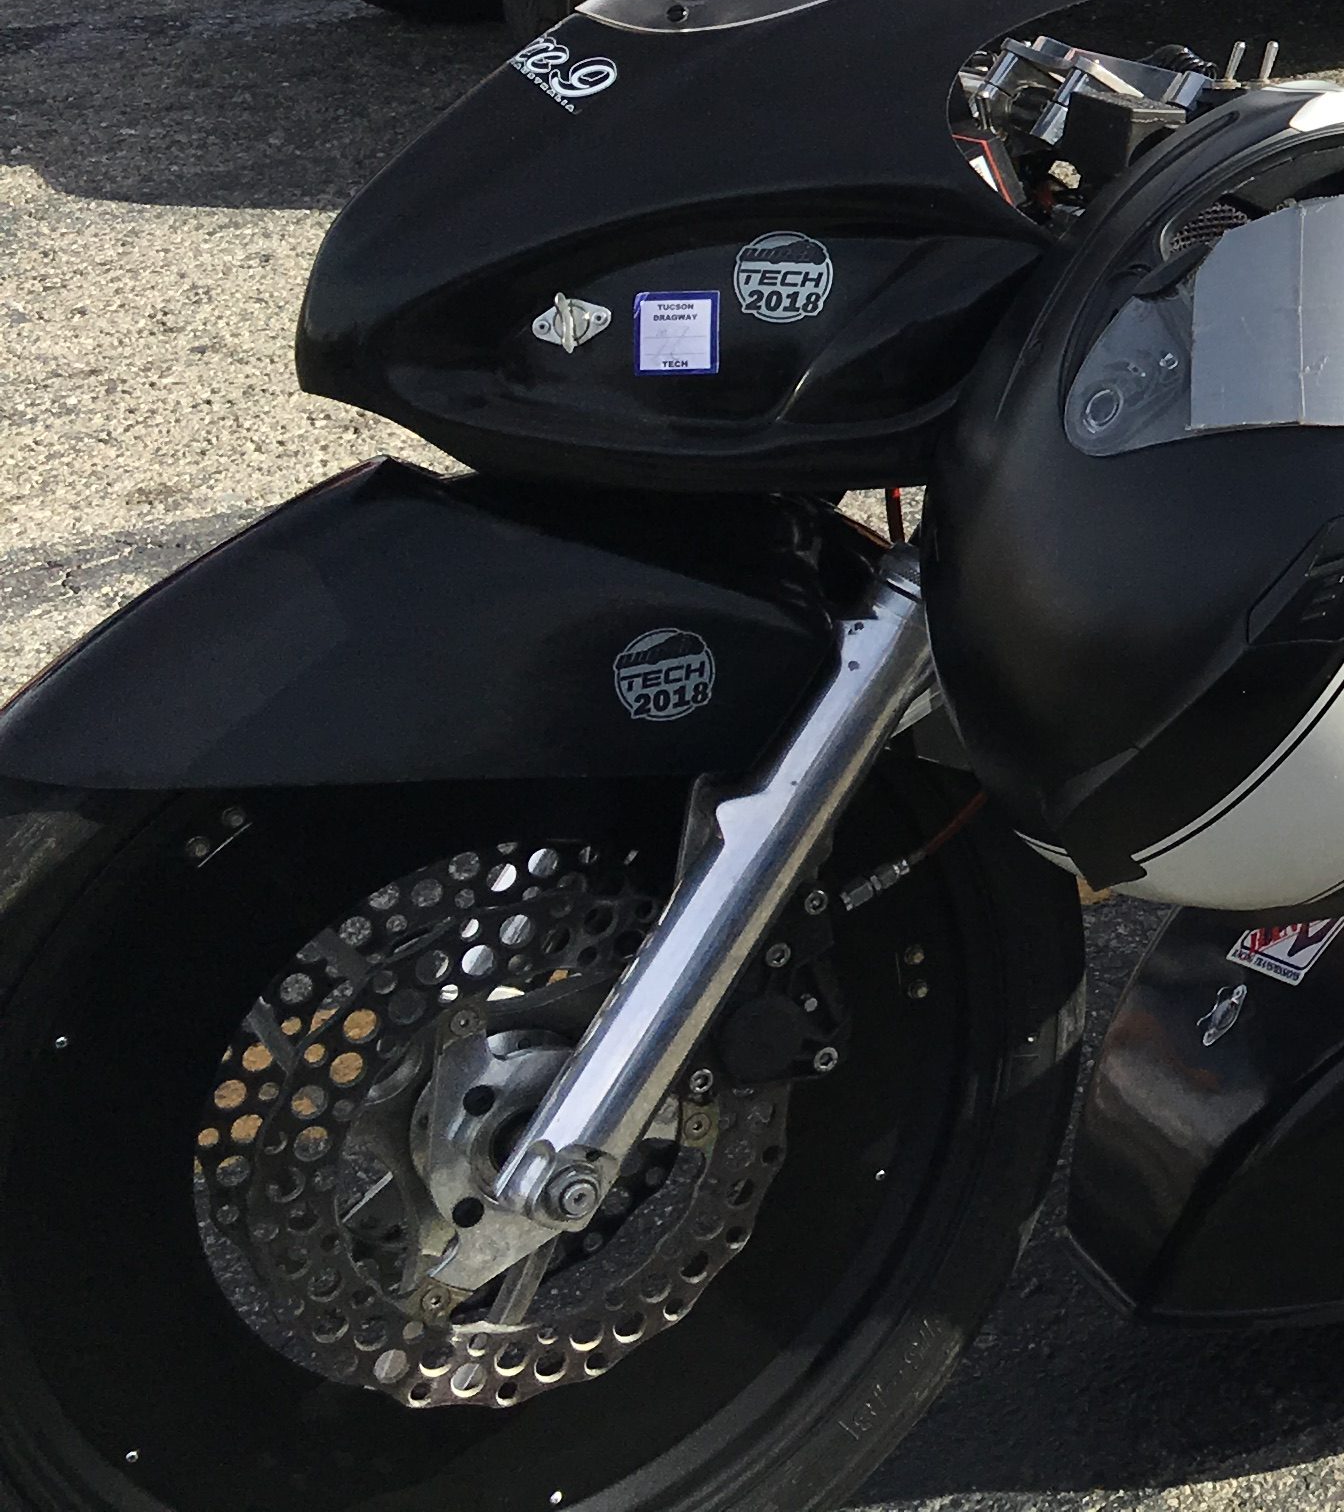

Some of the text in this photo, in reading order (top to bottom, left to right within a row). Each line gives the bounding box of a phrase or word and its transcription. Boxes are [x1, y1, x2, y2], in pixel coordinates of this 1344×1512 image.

[740, 268, 824, 289] TECH
[656, 302, 695, 312] TUCSON
[744, 289, 823, 314] 2018
[652, 313, 698, 323] DRAGWAY
[661, 359, 689, 369] TECH
[620, 660, 706, 693] TECH
[633, 681, 710, 717] 2018
